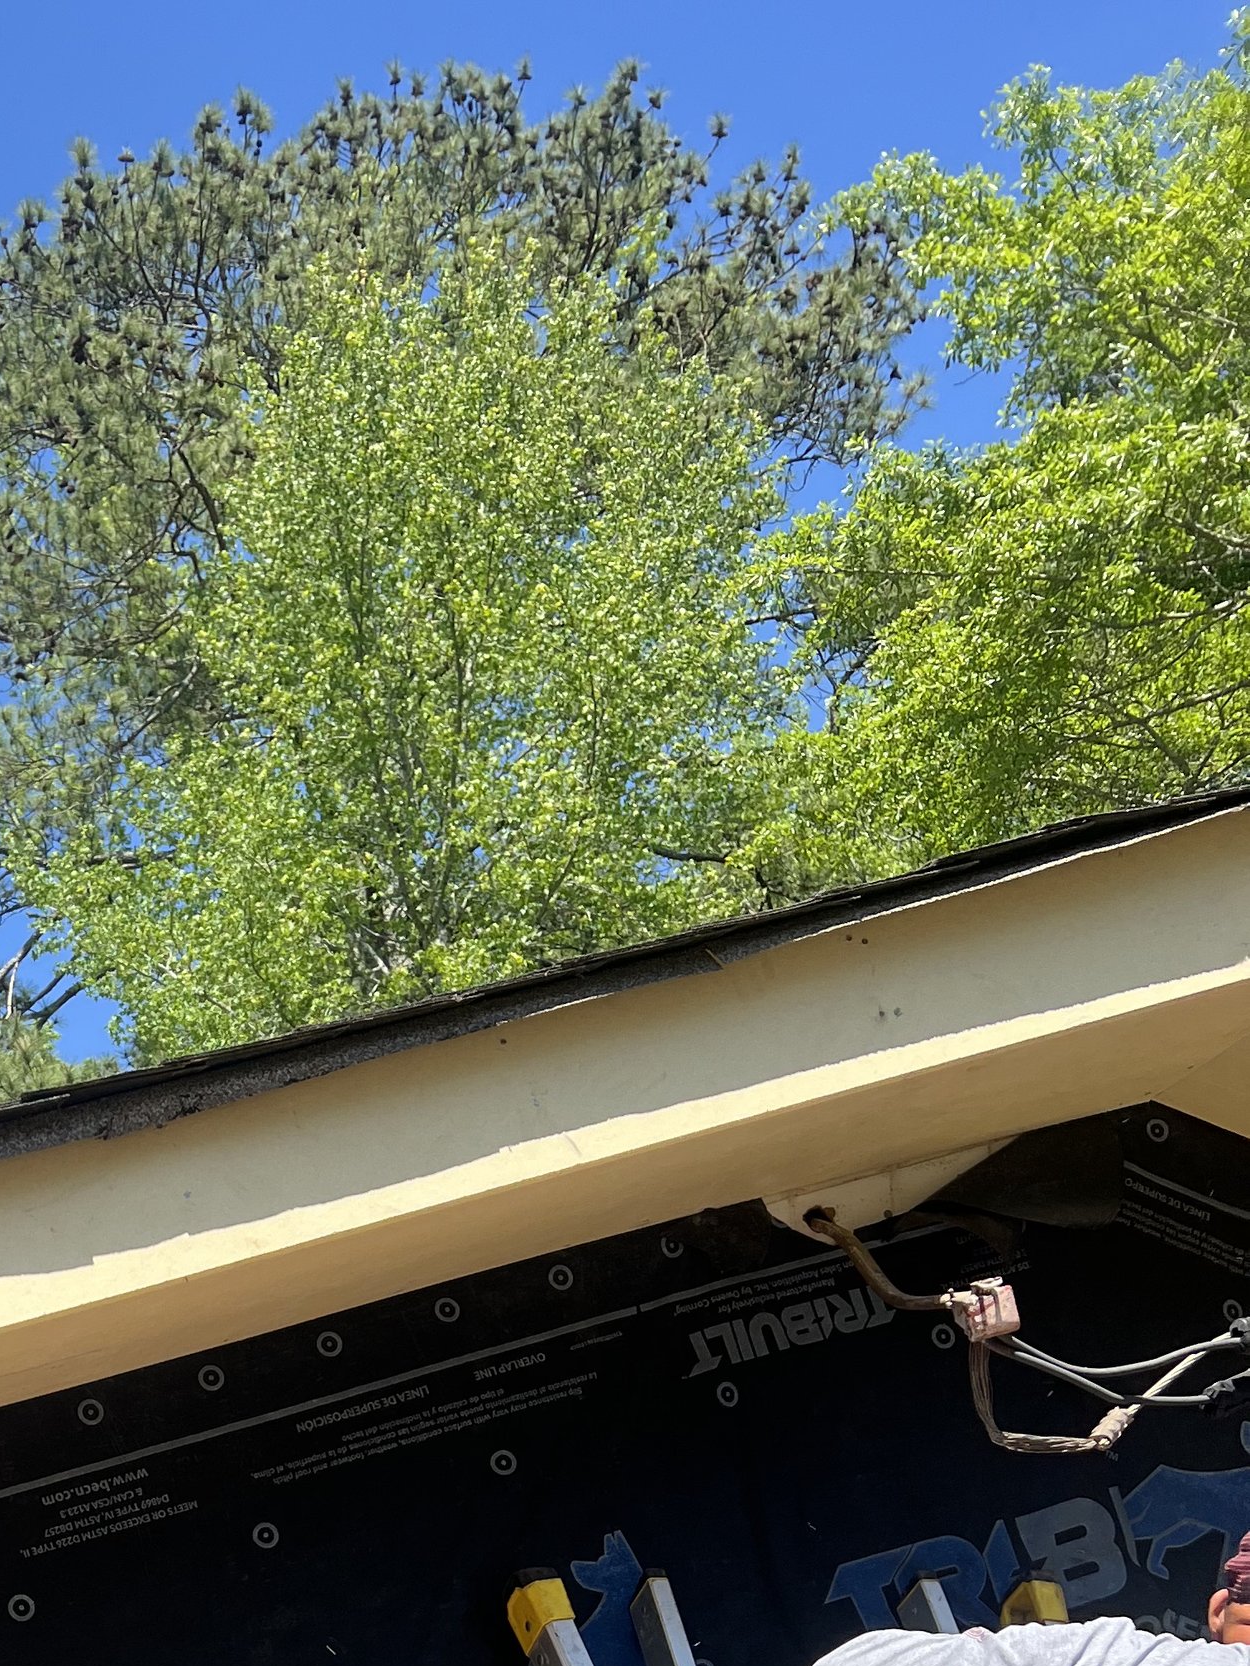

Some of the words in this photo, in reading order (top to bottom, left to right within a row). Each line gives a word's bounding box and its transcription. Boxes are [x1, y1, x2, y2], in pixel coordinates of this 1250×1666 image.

[688, 1278, 896, 1378] TRIBUILT
[498, 1352, 546, 1373] OVERLAP
[473, 1366, 498, 1381] LINE
[381, 1395, 397, 1407] DE
[396, 1385, 430, 1402] LÍNEA
[296, 1399, 382, 1433] SUPERPOSICIÓN
[41, 1468, 149, 1506] www.becn.com
[141, 1494, 170, 1509] D4869
[167, 1500, 198, 1516] MEETS
[115, 1503, 140, 1517] TYPE
[151, 1509, 166, 1520] OR
[74, 1514, 100, 1529] ASTM
[109, 1513, 151, 1533] EXCEEDS
[44, 1522, 73, 1538] D8257
[81, 1526, 108, 1541] ASTM
[55, 1534, 81, 1548] D226
[31, 1542, 56, 1556] TYPE
[825, 1486, 1140, 1632] TRIB
